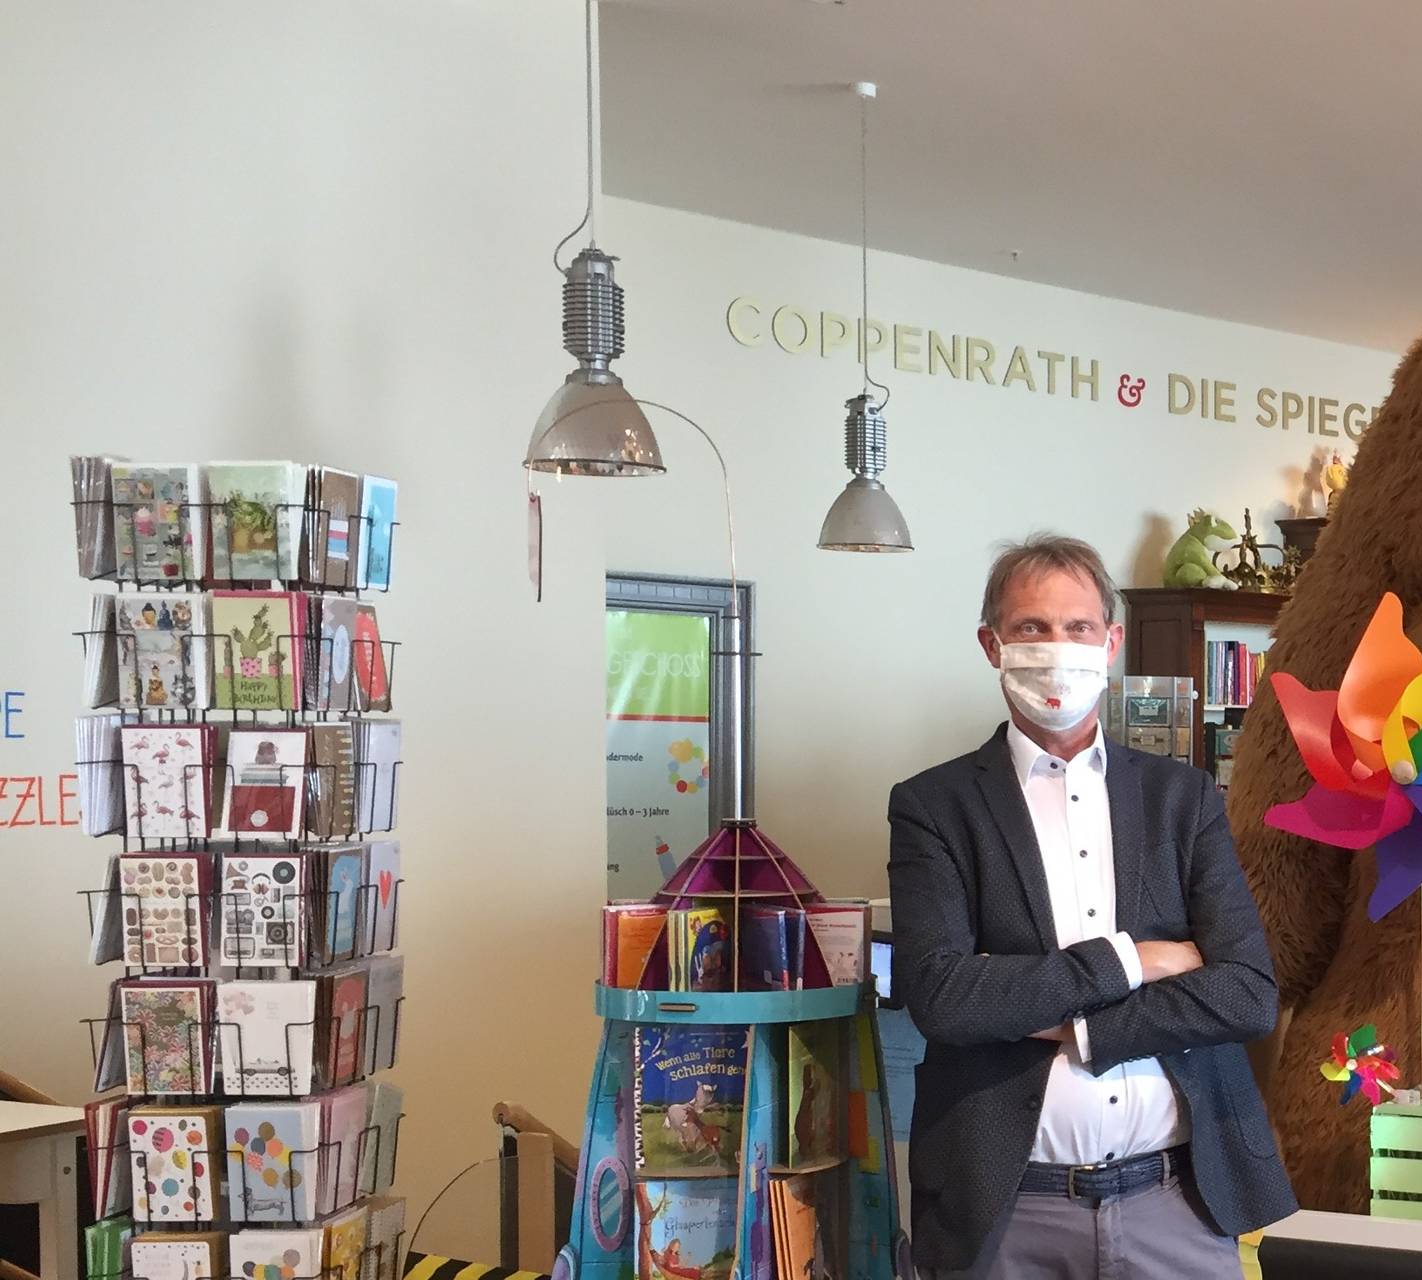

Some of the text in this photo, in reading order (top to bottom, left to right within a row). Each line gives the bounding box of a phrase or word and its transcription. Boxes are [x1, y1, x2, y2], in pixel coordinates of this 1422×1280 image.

[726, 296, 1100, 401] COPPENRATH
[1117, 373, 1146, 408] &
[1167, 372, 1237, 423] DIE
[0, 691, 25, 738] E
[670, 1062, 726, 1081] schlafen
